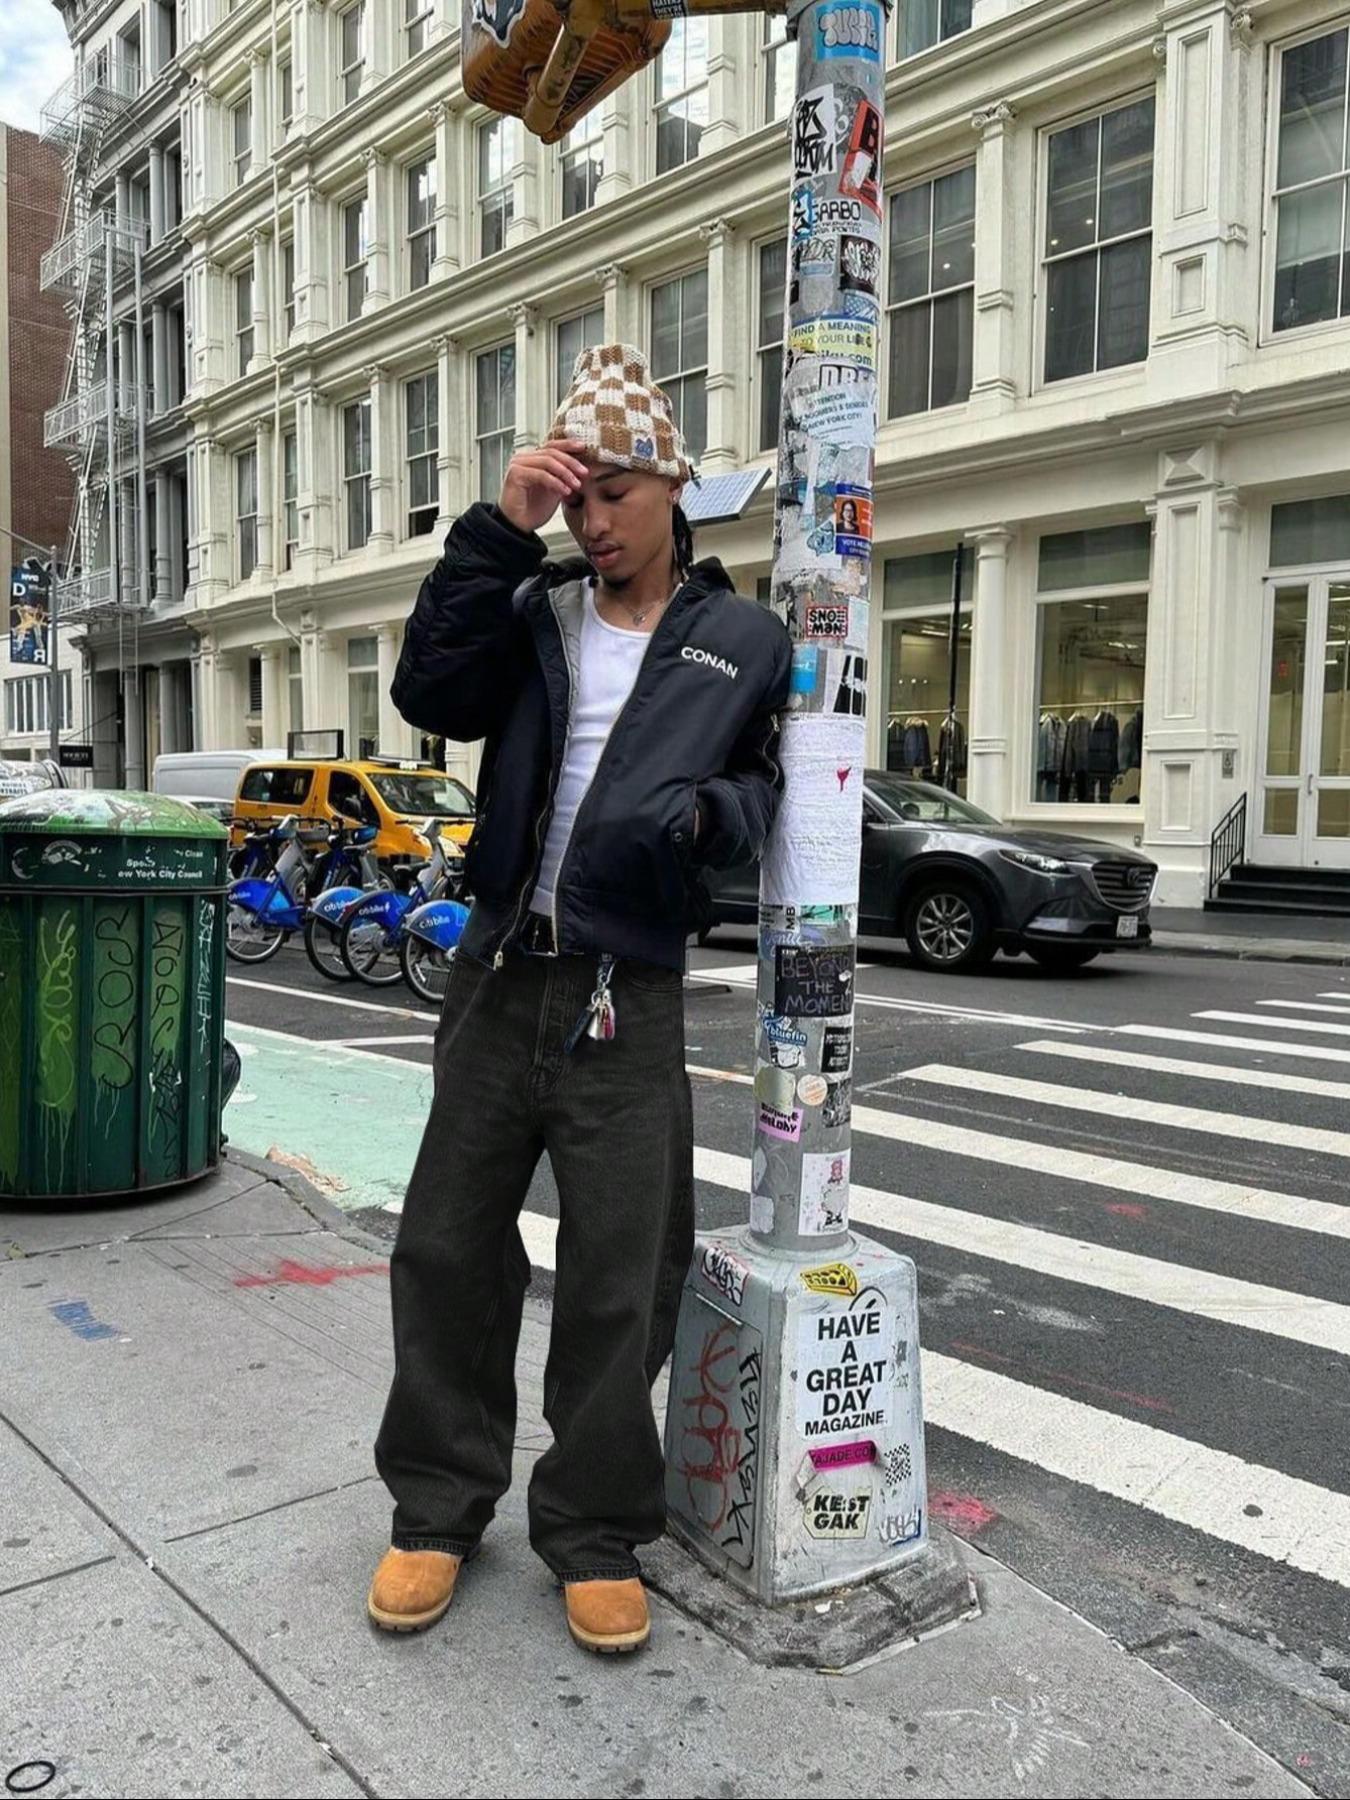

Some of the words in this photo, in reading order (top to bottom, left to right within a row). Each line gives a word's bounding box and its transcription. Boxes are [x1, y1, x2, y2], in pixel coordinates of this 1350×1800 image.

[681, 646, 738, 679] CONAN
[135, 869, 157, 878] York
[158, 869, 176, 880] City
[177, 869, 203, 878] Council
[799, 981, 834, 995] THE
[770, 1026, 807, 1042] bluefin
[818, 1312, 881, 1340] HAVE
[841, 1340, 857, 1363] A
[806, 1360, 887, 1392] GREAT
[823, 1387, 872, 1416] DAY
[805, 1409, 885, 1436] MAGAZINE
[814, 1512, 860, 1530] GAK
